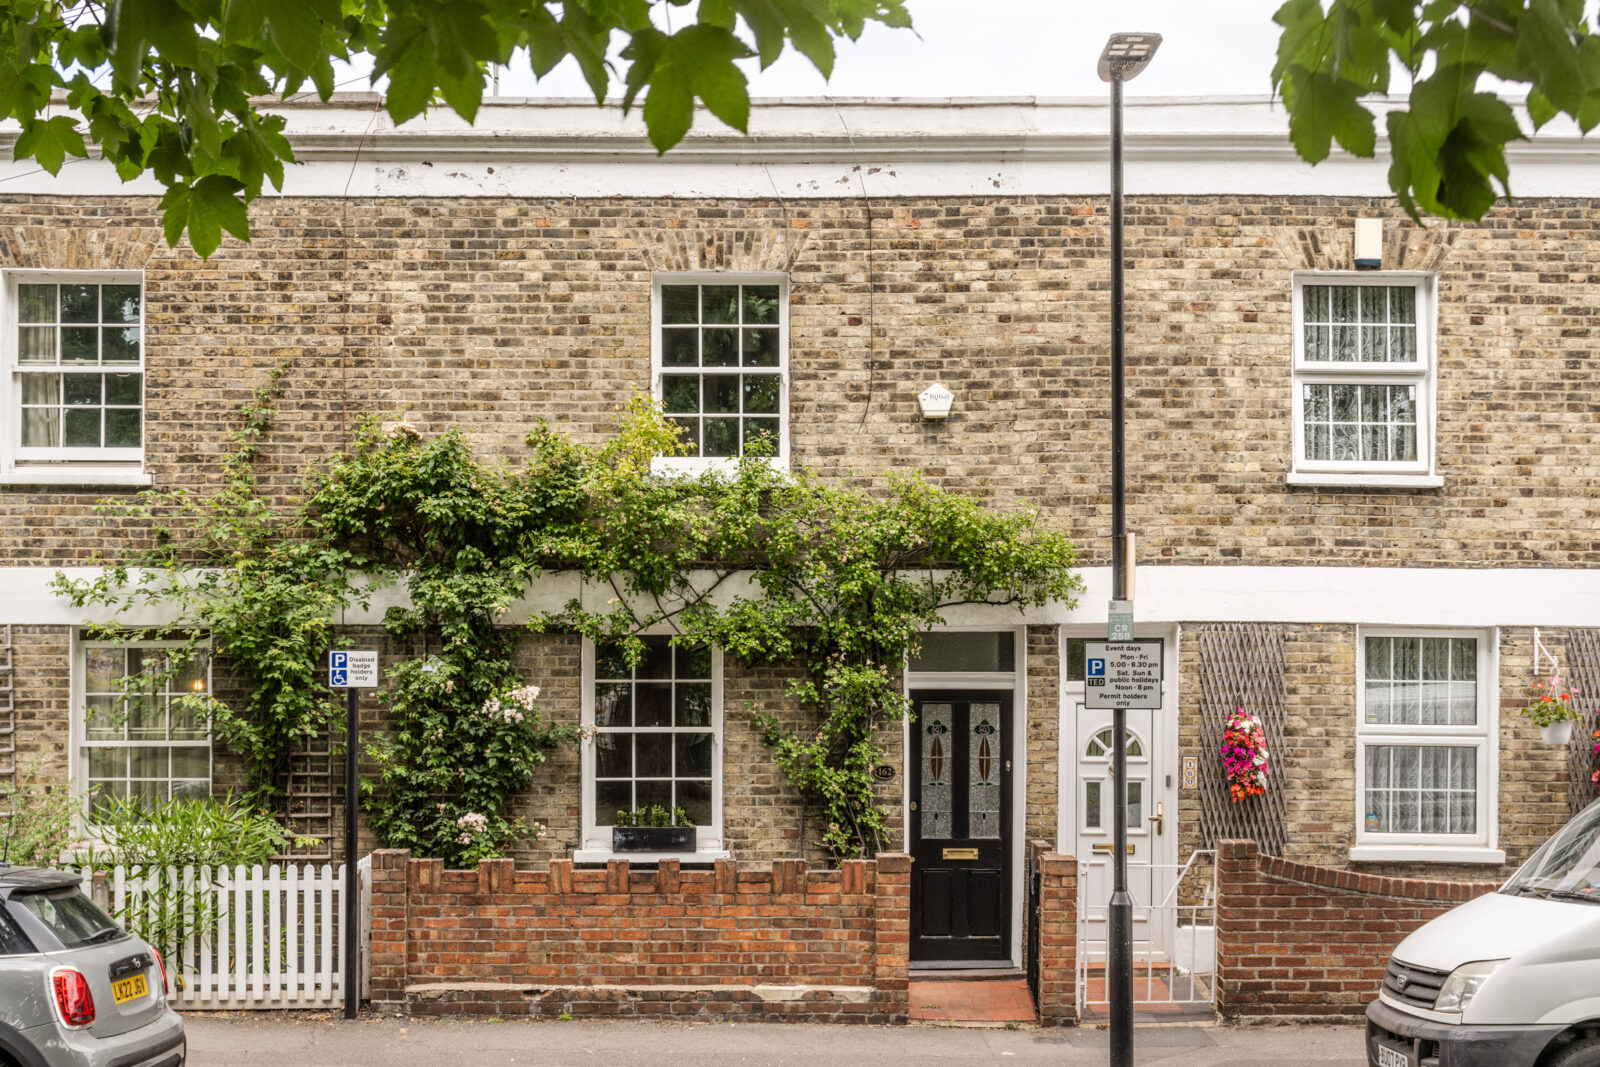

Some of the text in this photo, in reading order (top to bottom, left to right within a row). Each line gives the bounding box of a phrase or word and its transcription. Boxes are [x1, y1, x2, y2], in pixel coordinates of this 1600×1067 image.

[1114, 624, 1128, 632] CR
[1111, 632, 1130, 640] 25B
[335, 654, 345, 667] P
[1092, 660, 1103, 674] P
[1088, 678, 1105, 686] TED
[878, 767, 892, 776] 162
[112, 980, 133, 1001] LK22
